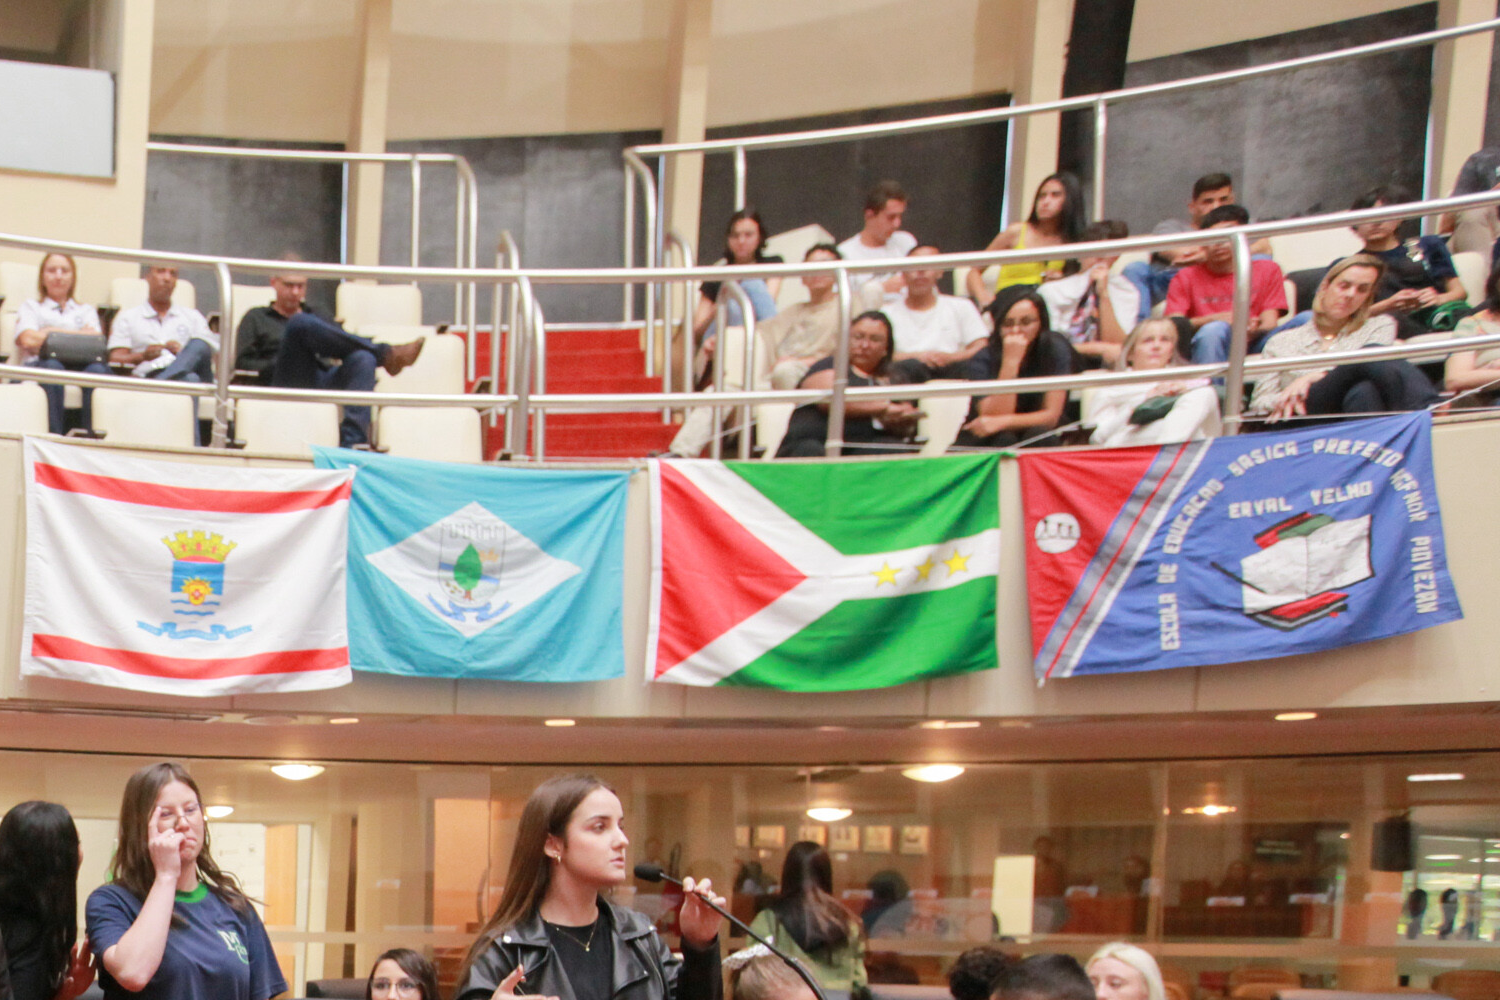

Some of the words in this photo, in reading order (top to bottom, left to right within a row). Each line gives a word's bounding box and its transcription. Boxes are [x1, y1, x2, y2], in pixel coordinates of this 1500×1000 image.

[1228, 497, 1293, 519] ERVAL
[1156, 563, 1178, 583] DE
[1158, 592, 1181, 650] ESCOLA
